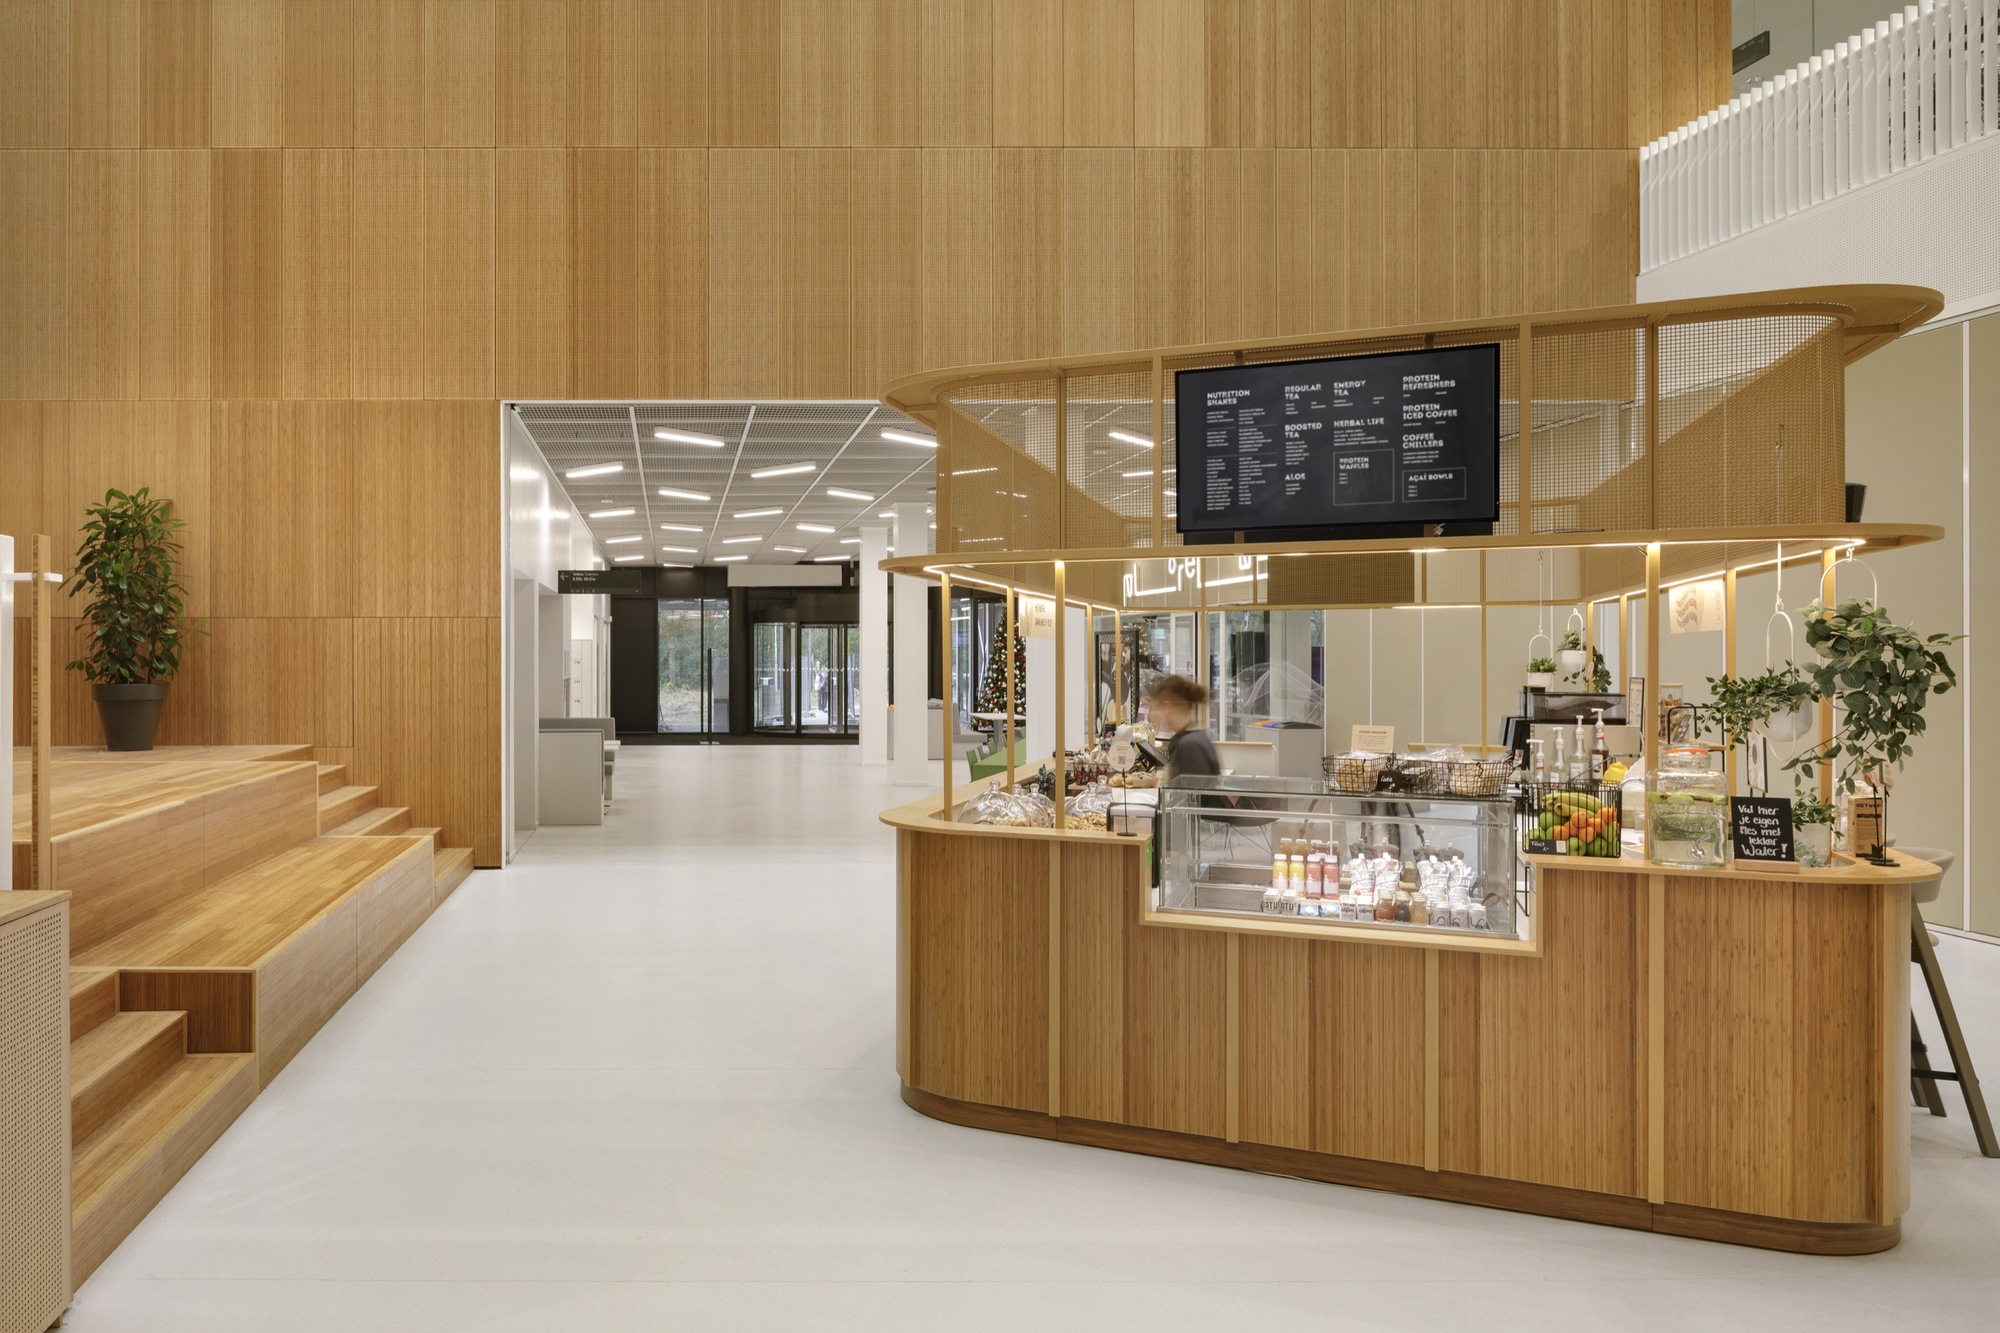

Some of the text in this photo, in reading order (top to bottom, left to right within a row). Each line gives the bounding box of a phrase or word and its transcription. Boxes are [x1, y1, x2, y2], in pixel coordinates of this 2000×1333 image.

[1403, 374, 1440, 383] PROTEIN
[1285, 384, 1322, 393] REGULAR
[1334, 380, 1366, 388] ENERGY
[1403, 380, 1456, 391] REFRESHERS
[1207, 390, 1250, 398] NUTRITION
[1207, 397, 1238, 406] SHAKES
[1403, 404, 1440, 412] PROTEIN
[1403, 409, 1458, 420] ICED COFFEE
[1285, 422, 1322, 431] BOOSTED
[1334, 419, 1365, 427] HERBAL
[1403, 433, 1434, 441] COFFEE
[1403, 440, 1444, 449] CHILLERS
[1738, 805, 1779, 815] Vul hier
[1739, 814, 1779, 828] je eigen
[1739, 826, 1782, 836] fles met
[1749, 837, 1778, 846] lekker
